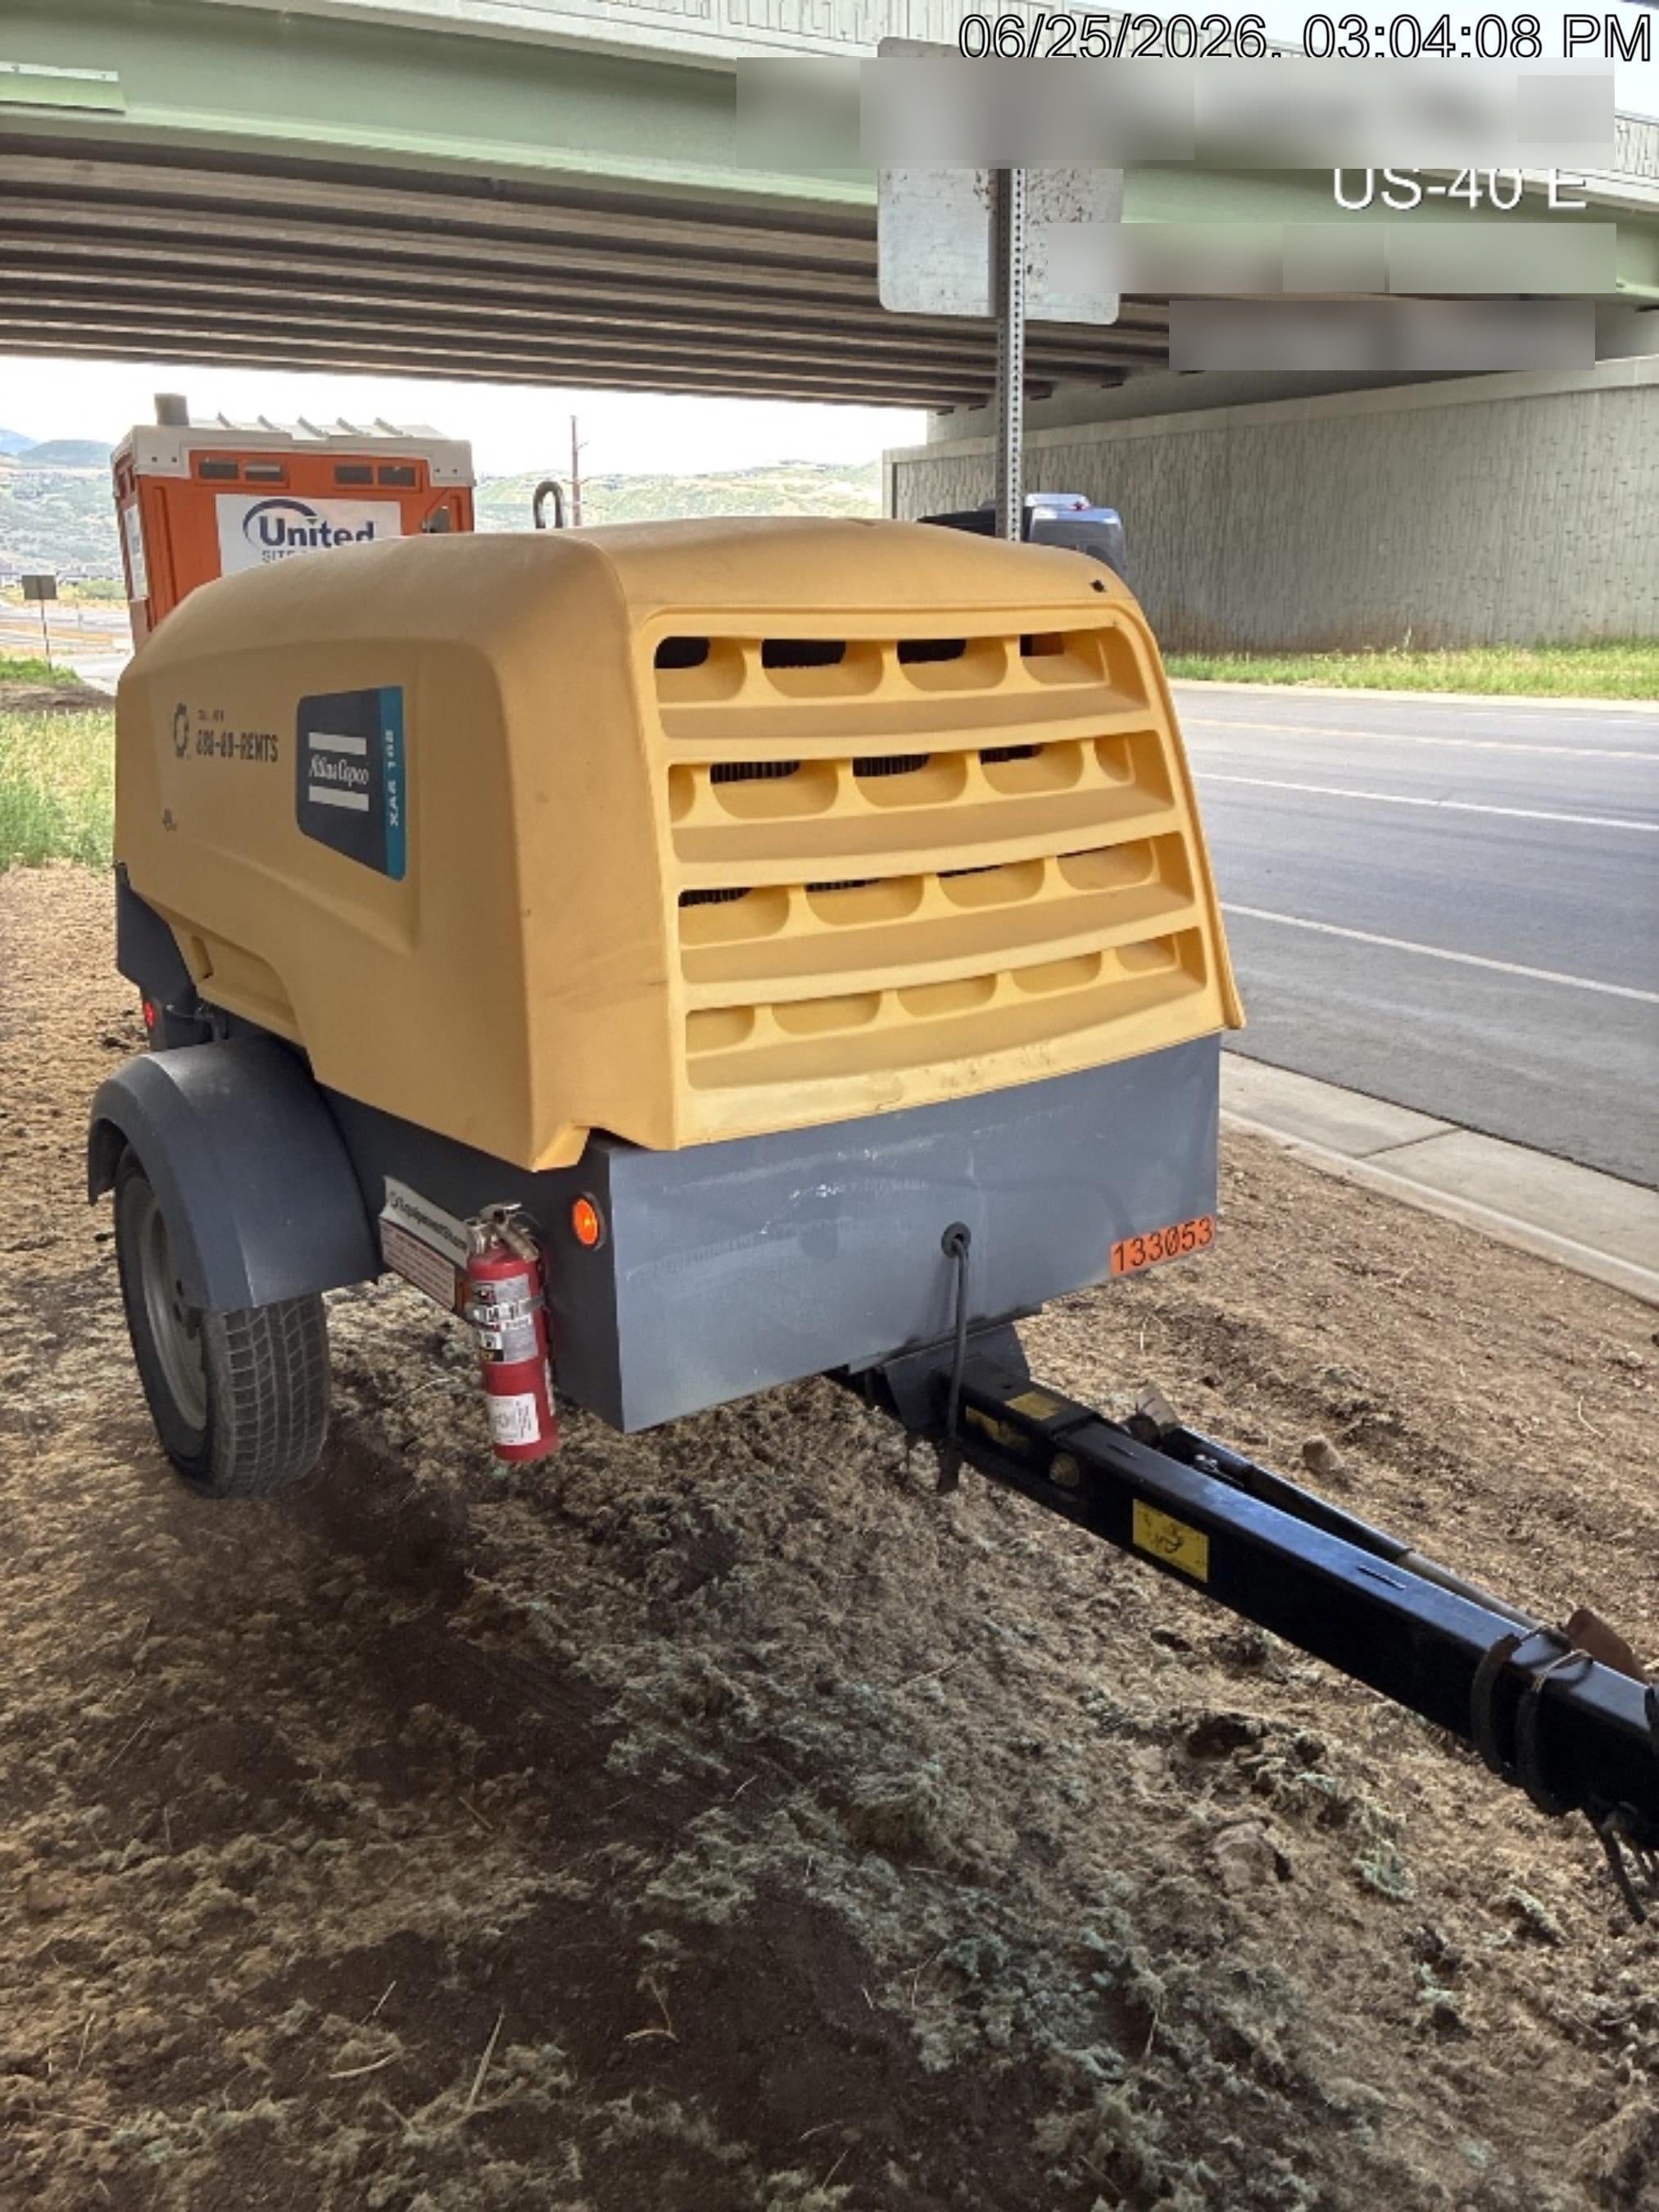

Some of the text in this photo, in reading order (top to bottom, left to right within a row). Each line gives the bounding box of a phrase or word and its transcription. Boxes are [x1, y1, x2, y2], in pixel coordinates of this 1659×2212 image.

[259, 515, 374, 547] United
[261, 550, 296, 564] SIT
[1113, 1216, 1213, 1271] 133053
